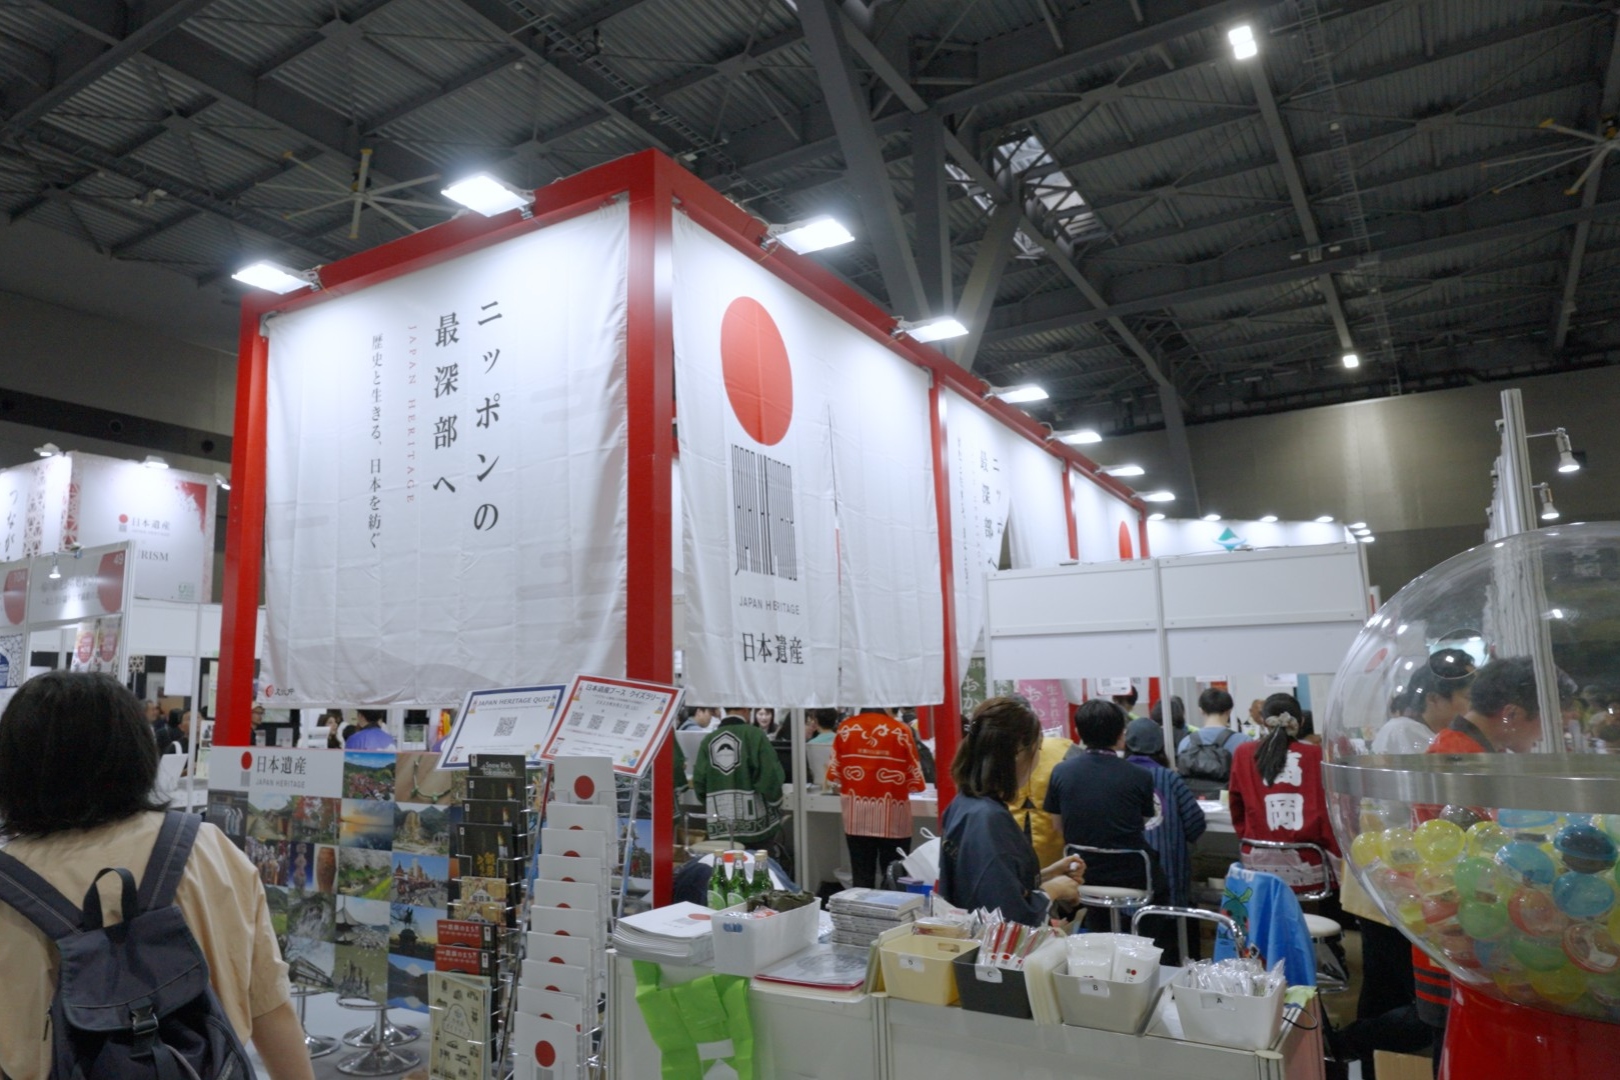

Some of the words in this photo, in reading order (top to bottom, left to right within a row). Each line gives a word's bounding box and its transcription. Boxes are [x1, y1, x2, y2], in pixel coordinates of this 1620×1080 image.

[407, 325, 418, 385] JAPAN
[433, 311, 460, 493] 最深部へ
[474, 300, 503, 531] ニッポンの
[406, 399, 417, 503] HERITAGE
[739, 596, 763, 609] JAPAN
[765, 600, 800, 615] HERITAGE
[742, 632, 804, 664] 日本遺産
[533, 695, 551, 703] QUIZ
[256, 755, 307, 775] 日本遺産
[256, 778, 274, 786] JAPAN
[275, 779, 305, 789] HERITAGE
[987, 970, 993, 978] C
[1092, 983, 1099, 992] B
